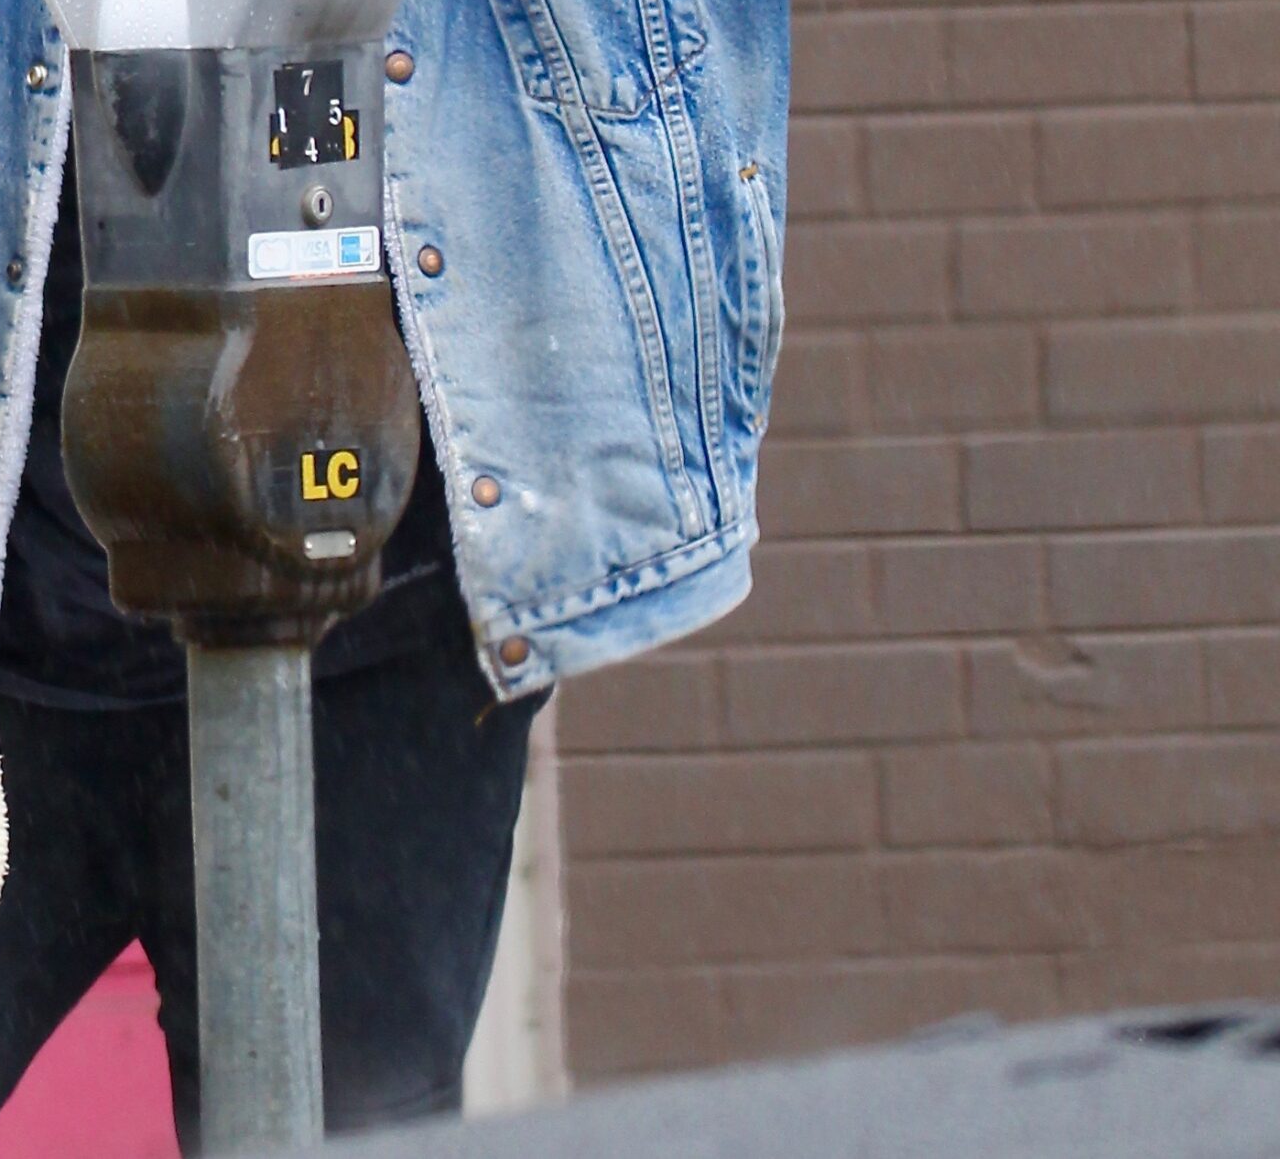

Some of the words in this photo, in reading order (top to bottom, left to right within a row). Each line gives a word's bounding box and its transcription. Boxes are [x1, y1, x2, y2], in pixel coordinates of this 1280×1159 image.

[302, 69, 314, 96] 7
[279, 107, 288, 134] 1
[329, 99, 342, 126] 5
[305, 136, 318, 163] 4
[302, 451, 360, 500] LC
